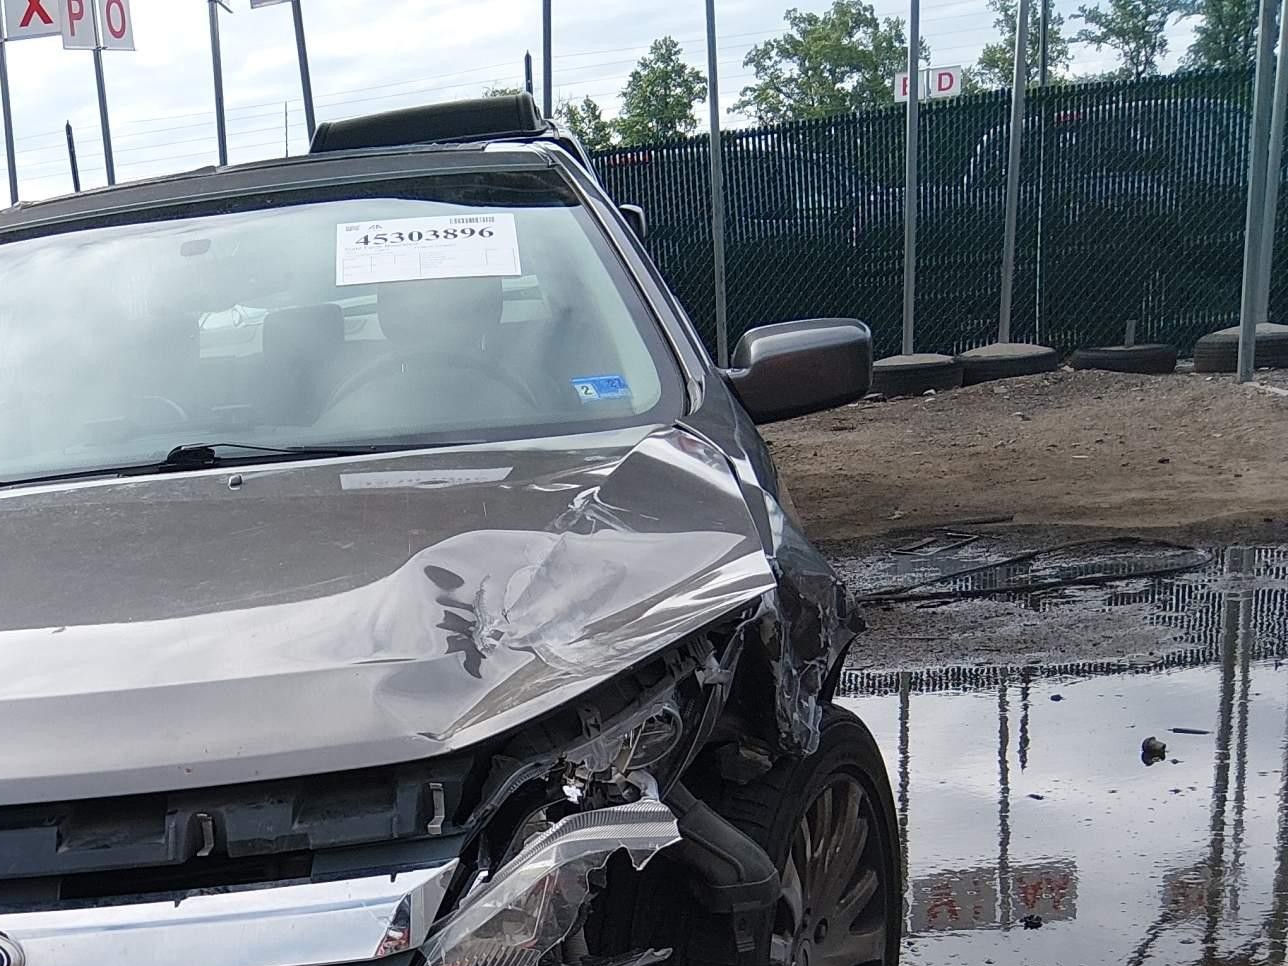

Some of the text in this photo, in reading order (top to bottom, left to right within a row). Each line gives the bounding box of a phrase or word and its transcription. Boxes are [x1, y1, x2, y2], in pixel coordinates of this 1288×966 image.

[938, 72, 954, 91] D
[355, 226, 494, 246] 45303896
[581, 385, 593, 395] 2
